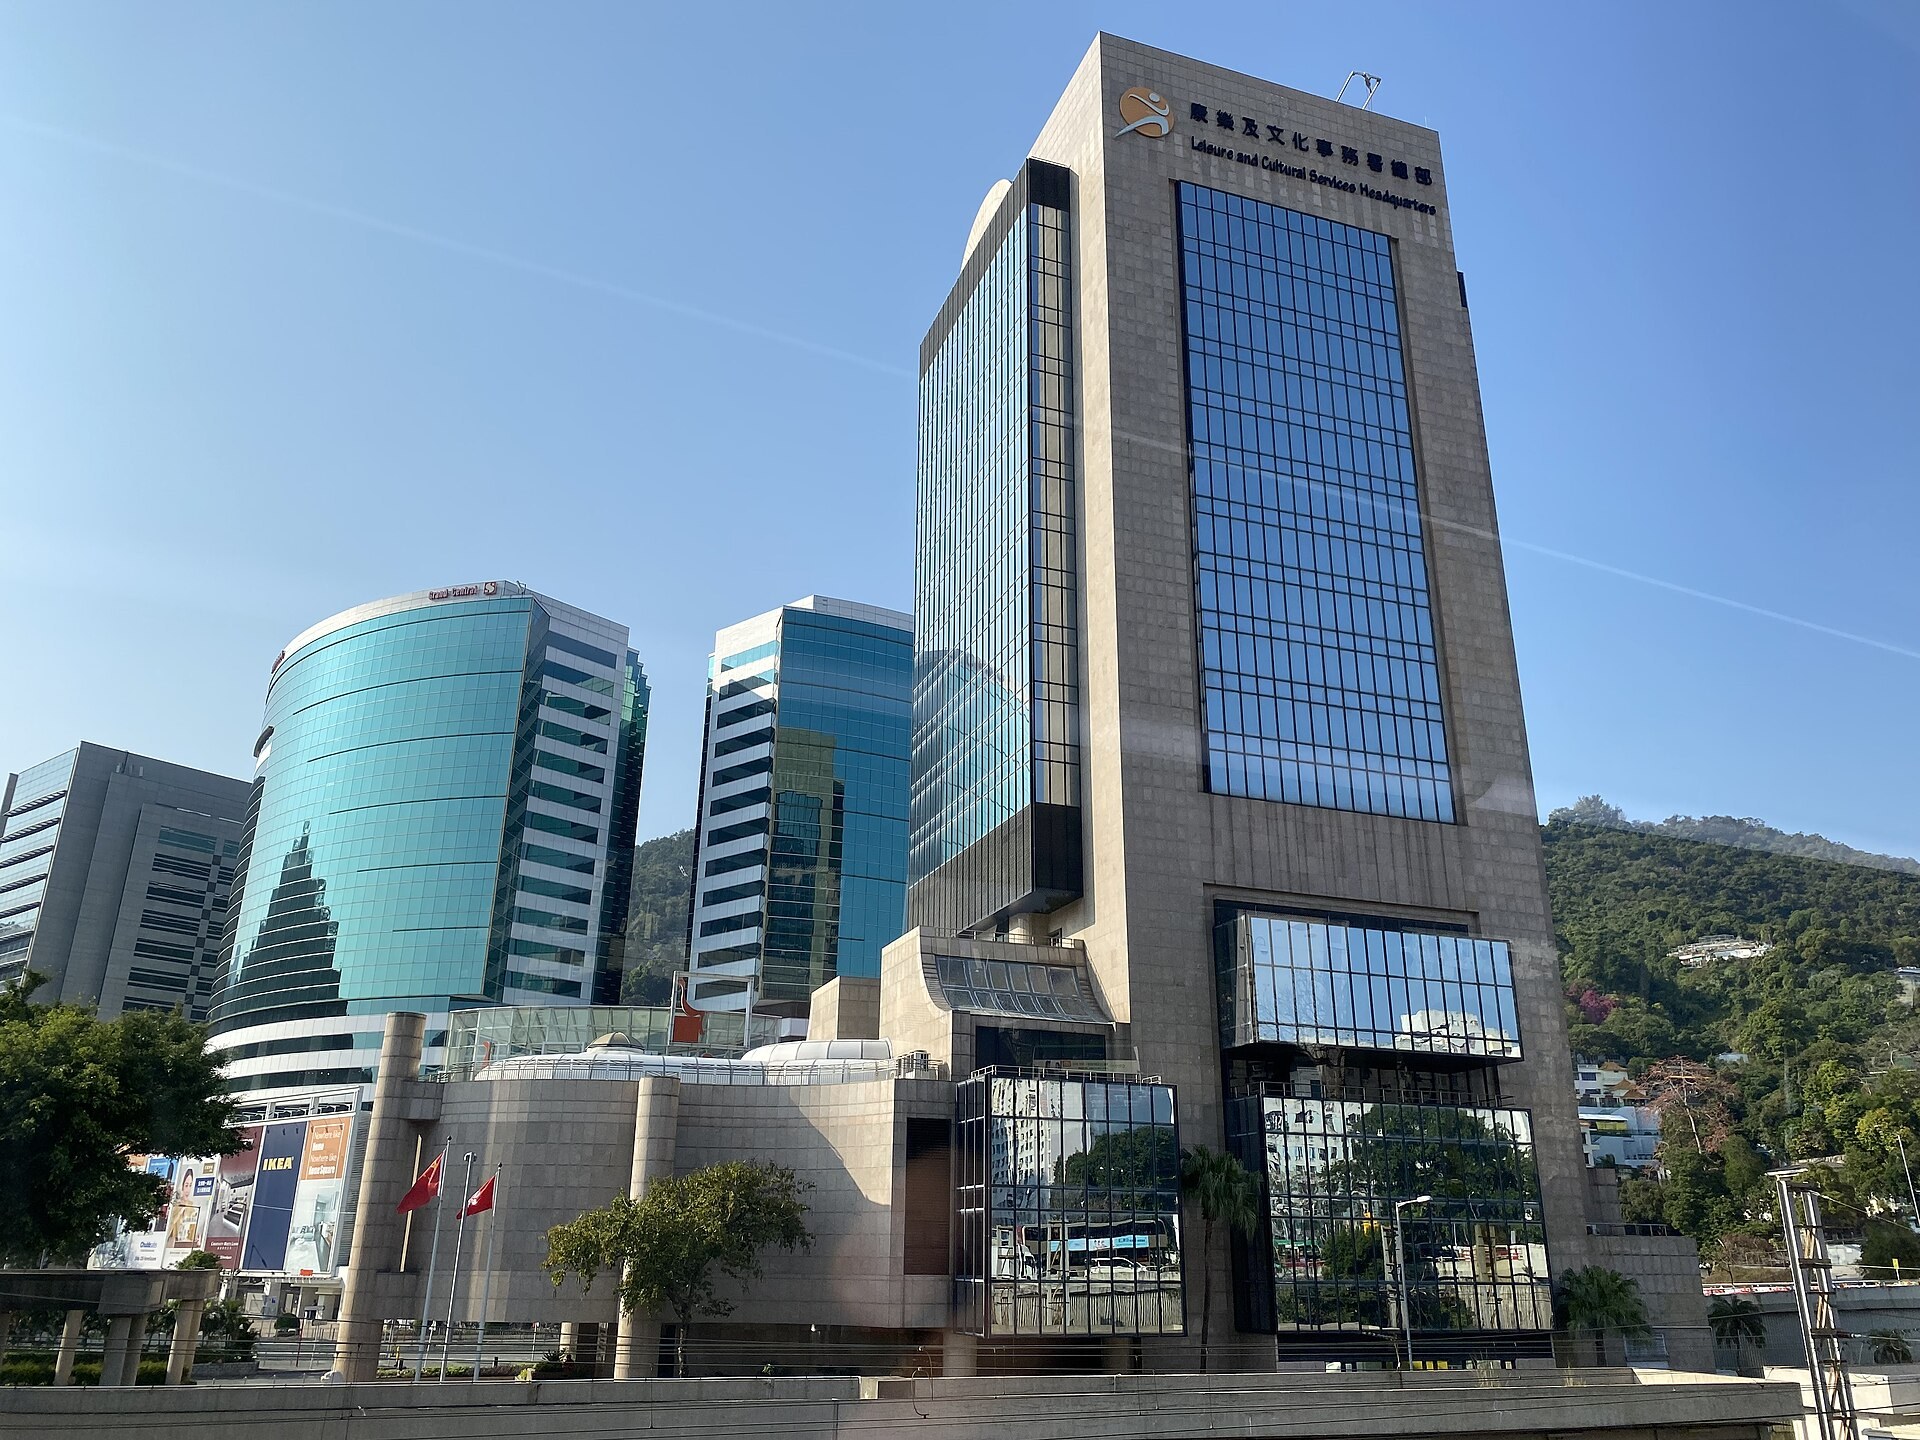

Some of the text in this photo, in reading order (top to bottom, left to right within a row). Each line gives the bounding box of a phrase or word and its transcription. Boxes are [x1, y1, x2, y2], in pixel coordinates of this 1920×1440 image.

[1190, 103, 1433, 186] 康樂及文化事務署總部
[1191, 136, 1436, 215] Leisure and Cultural Services Headquarters
[429, 589, 448, 600] Grand
[452, 585, 478, 597] Central
[262, 1157, 293, 1171] IKEA
